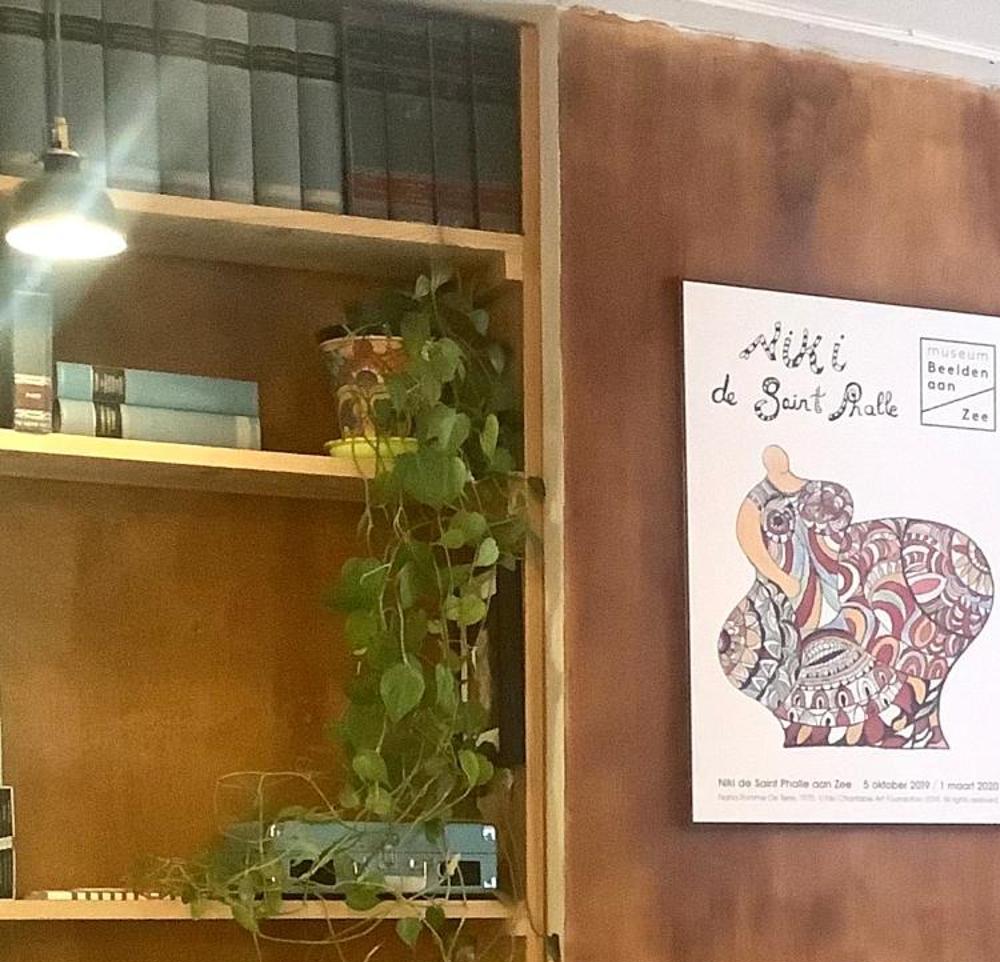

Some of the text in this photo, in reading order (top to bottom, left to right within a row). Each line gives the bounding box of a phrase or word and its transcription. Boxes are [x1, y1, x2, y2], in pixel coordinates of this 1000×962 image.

[927, 346, 989, 361] museum
[927, 361, 989, 379] Beelden
[927, 379, 956, 392] aan
[711, 374, 899, 422] de Saint Phalle
[961, 408, 989, 422] Zee
[718, 778, 852, 789] Niki de Saint Phalle aan Zee
[871, 780, 907, 790] oktober
[909, 780, 930, 790] 2019
[947, 781, 975, 791] maart
[977, 782, 999, 791] 2020
